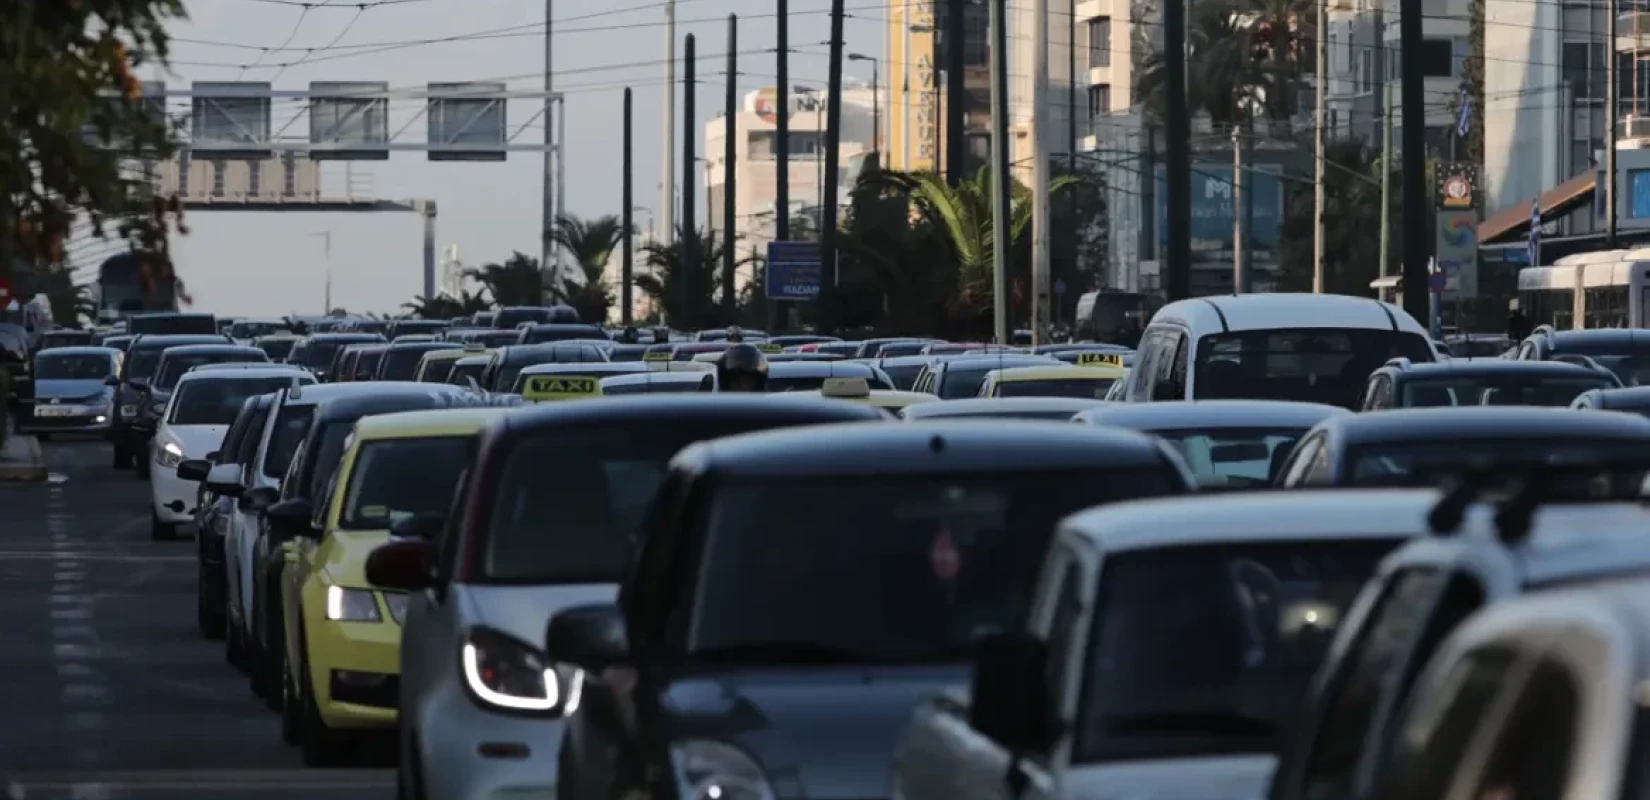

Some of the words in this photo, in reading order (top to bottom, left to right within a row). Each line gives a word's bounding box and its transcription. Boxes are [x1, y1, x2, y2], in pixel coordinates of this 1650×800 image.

[917, 54, 934, 160] AVENUE
[1081, 353, 1119, 363] TAXI
[534, 380, 593, 391] TAXI
